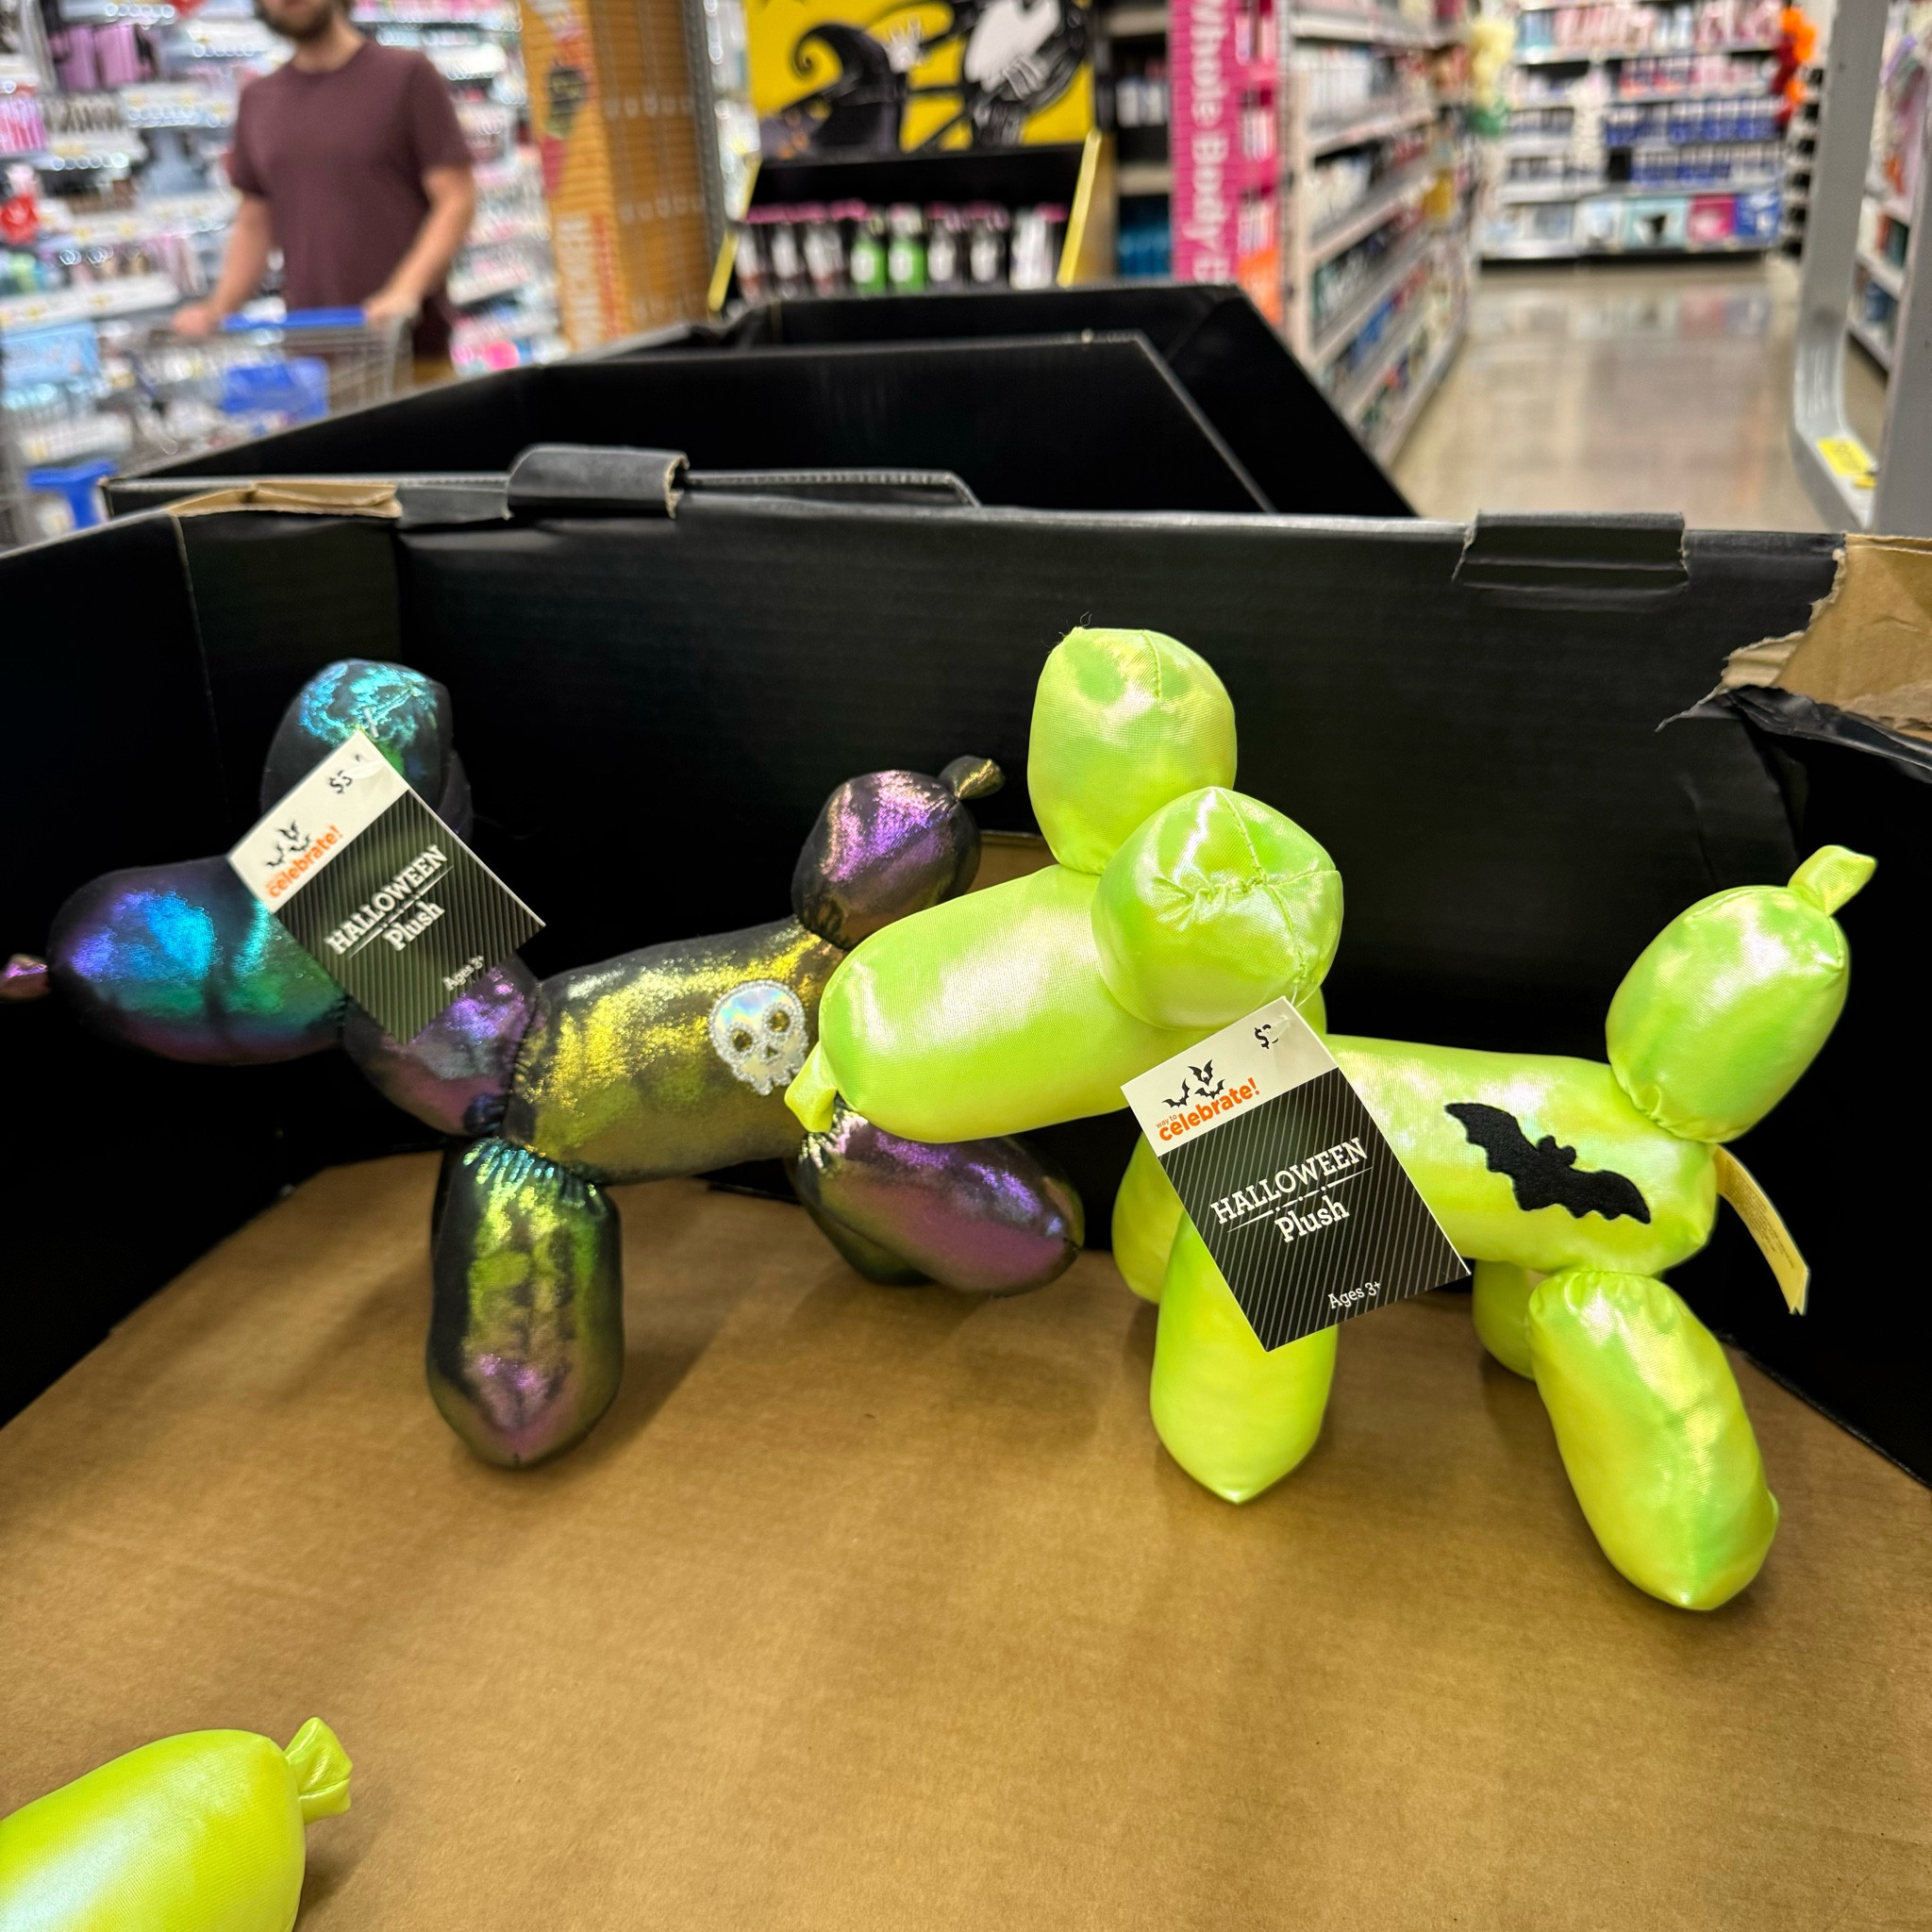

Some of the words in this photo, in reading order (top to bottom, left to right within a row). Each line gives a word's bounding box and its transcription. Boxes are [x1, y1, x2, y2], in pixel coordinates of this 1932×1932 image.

[1182, 132, 1230, 250] Body
[268, 824, 343, 897] celebrate!
[324, 844, 448, 955] HALLOWEEN
[382, 901, 445, 951] Plush
[442, 963, 475, 991] Ages
[1156, 1117, 1170, 1129] way
[1158, 1077, 1260, 1141] celebrate!
[1210, 1137, 1368, 1224] HALLOWEEN
[1274, 1195, 1350, 1242] Plush
[1328, 1286, 1365, 1309] Ages
[1365, 1280, 1381, 1296] 3+
